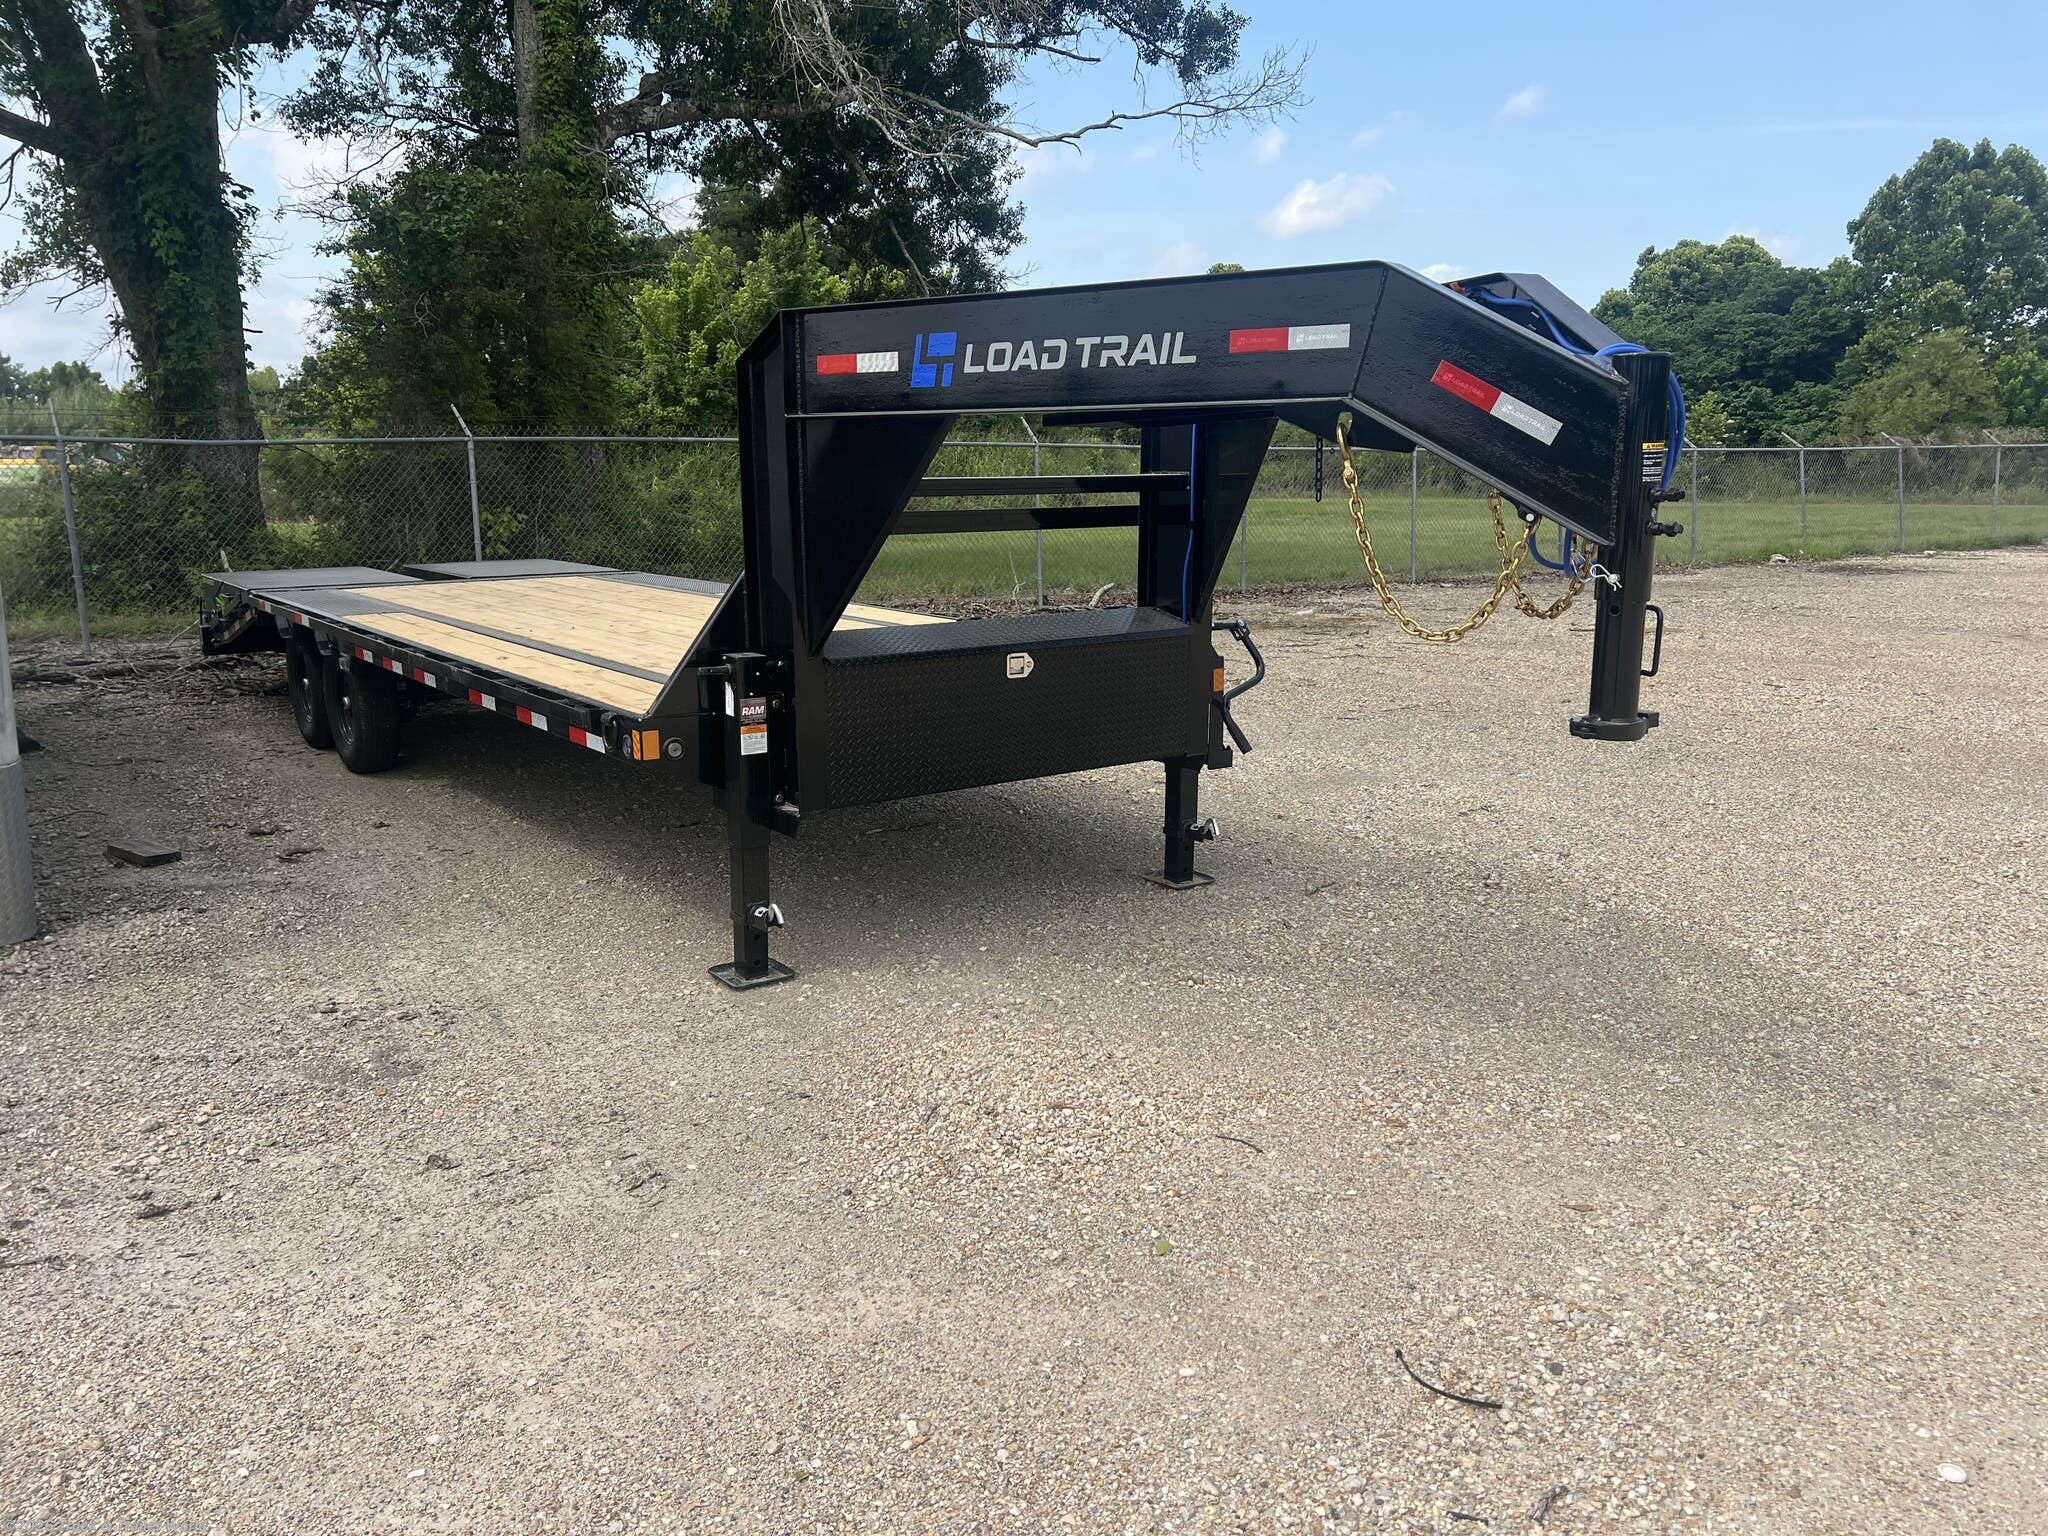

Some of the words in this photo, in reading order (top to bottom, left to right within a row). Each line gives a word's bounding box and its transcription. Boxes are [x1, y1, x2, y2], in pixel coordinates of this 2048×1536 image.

[963, 338, 1068, 373] LOAD
[1075, 331, 1197, 368] TRAIL
[742, 706, 764, 715] RAM
